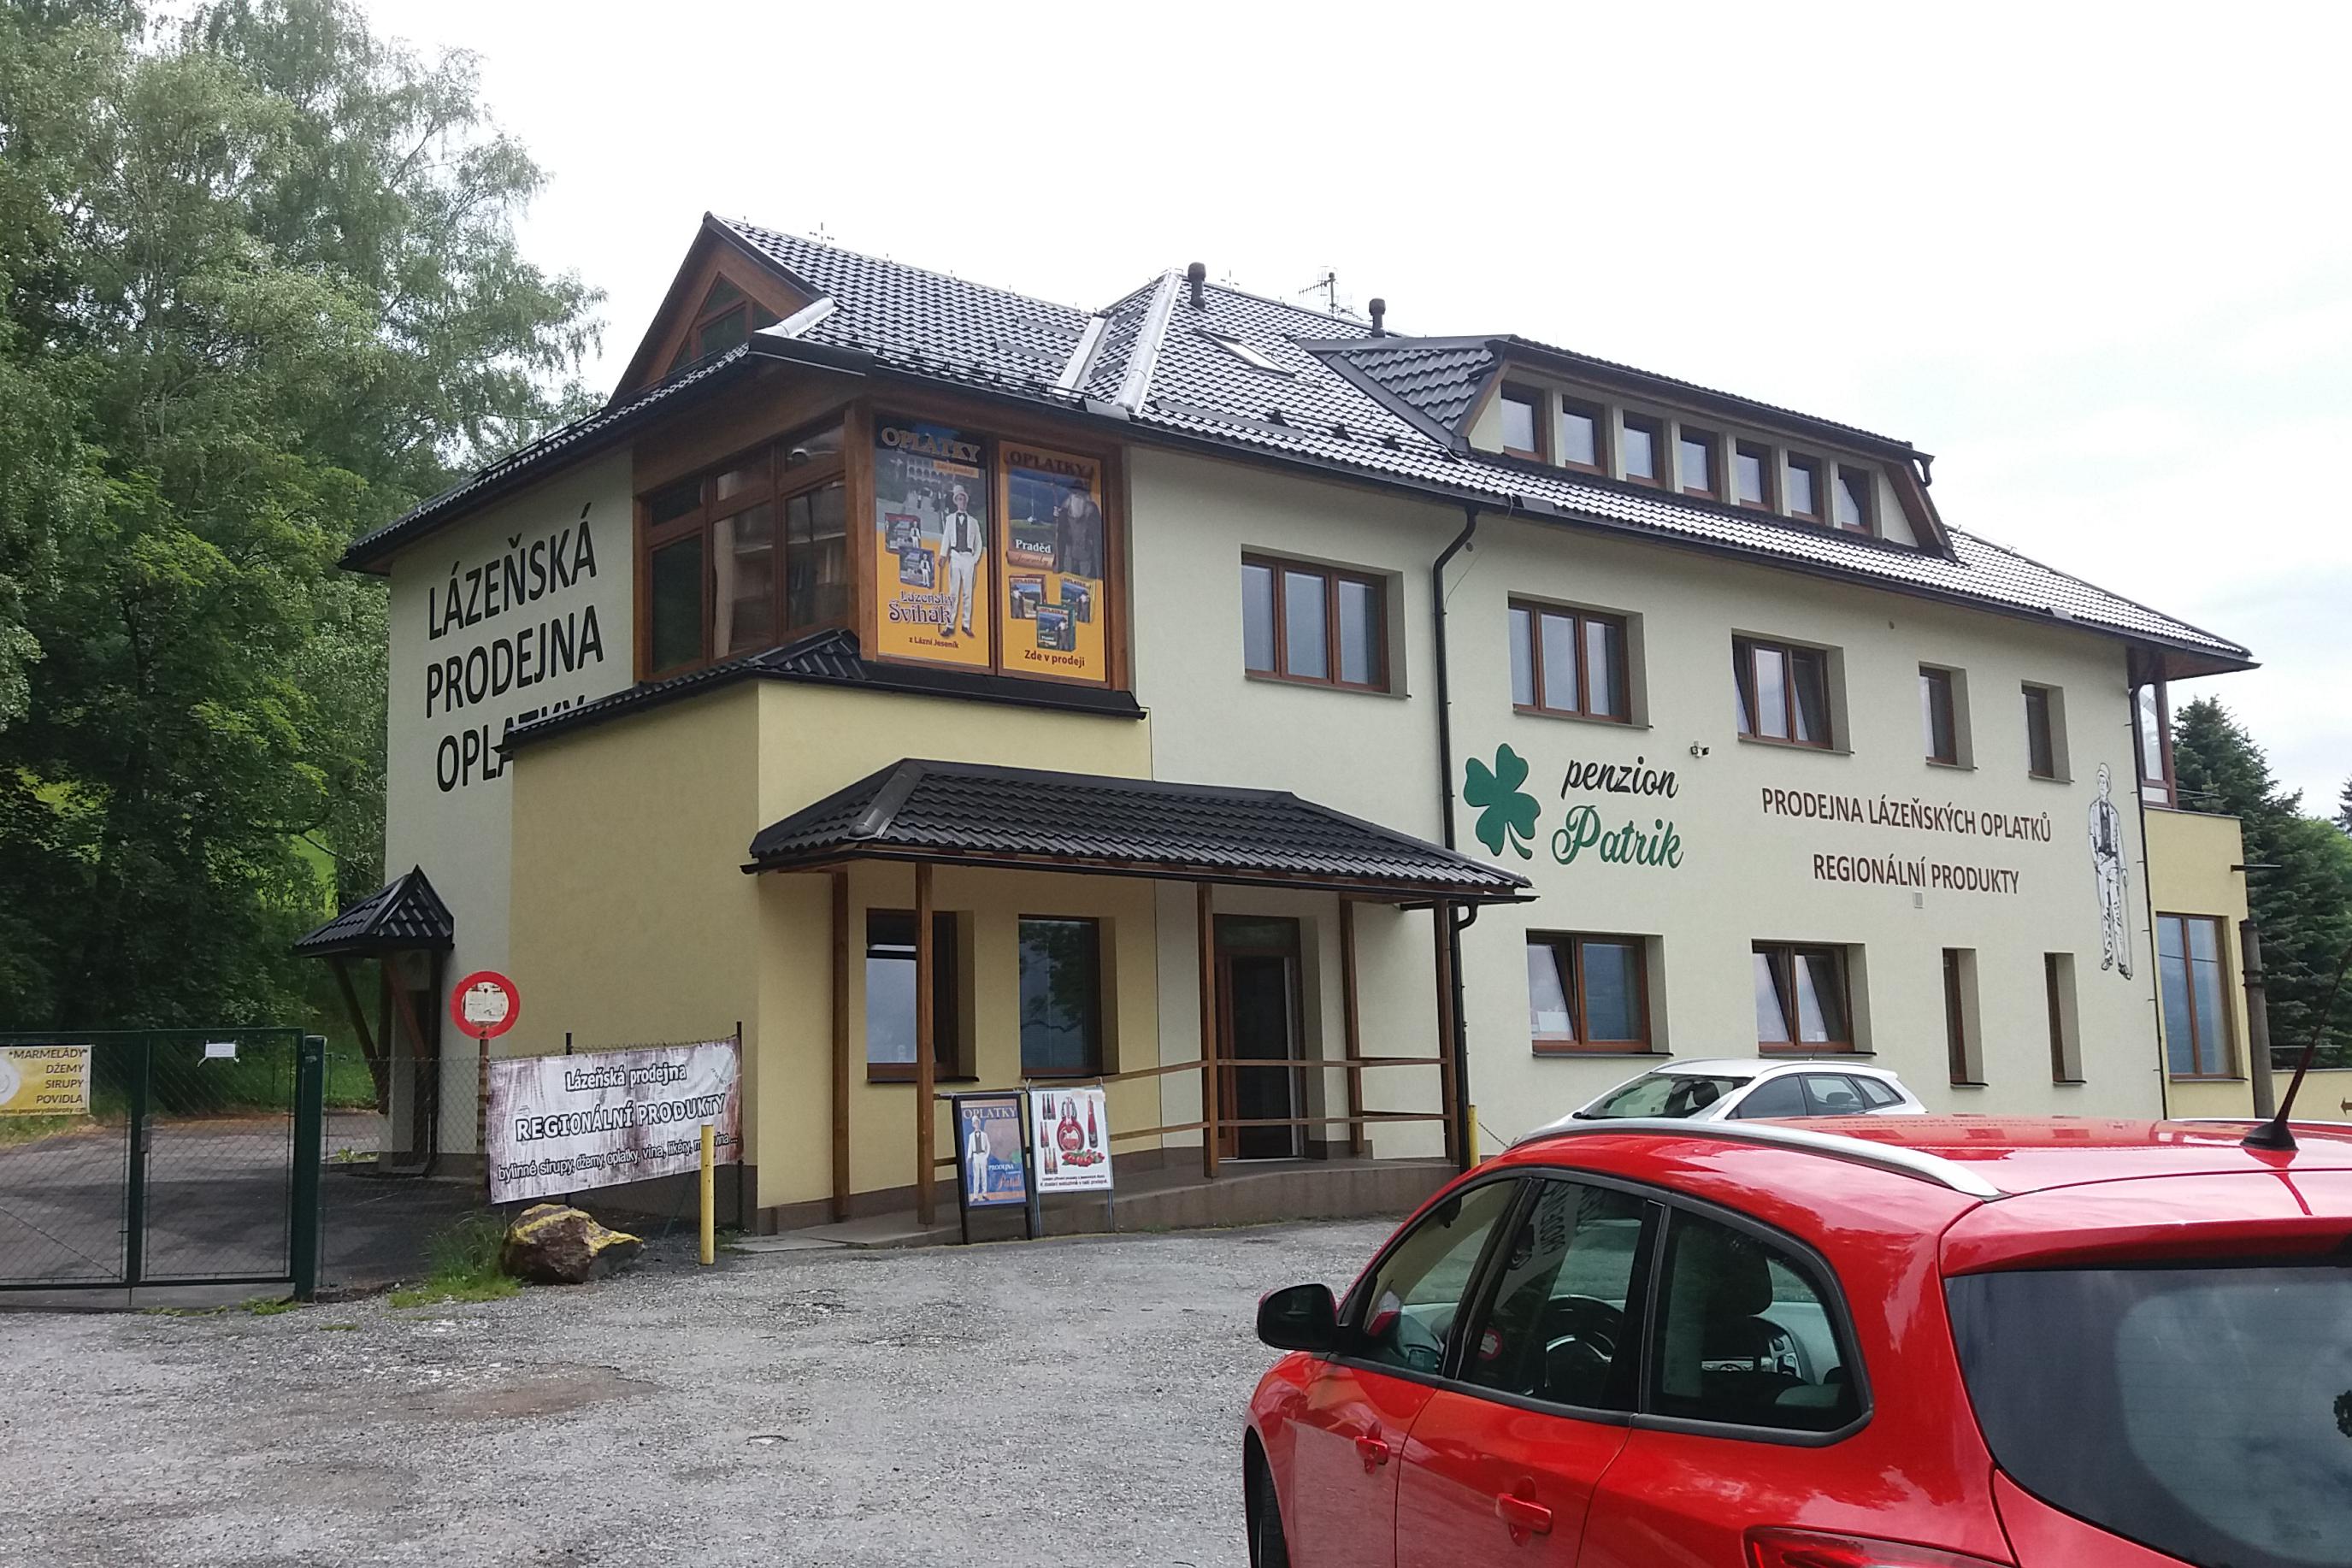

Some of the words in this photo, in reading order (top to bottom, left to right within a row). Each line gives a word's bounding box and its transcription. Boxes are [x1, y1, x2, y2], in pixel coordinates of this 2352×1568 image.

[881, 427, 981, 463] OPLATKY
[1009, 451, 1086, 476] OPLATKY
[429, 502, 598, 640] LÁZEŇSKÁ
[888, 600, 952, 624] Švihák
[426, 604, 604, 718] PRODEJNA
[1024, 650, 1042, 661] Zde
[1052, 653, 1085, 668] prodeji
[1560, 755, 1678, 799] penzion
[1761, 787, 1864, 823] PRODEJNA
[1868, 793, 1976, 835] LÁZEŇSKÝCH
[1980, 811, 2051, 842] OPLATKŮ
[1551, 805, 1684, 869] Patrik
[1813, 852, 1926, 887] REGIONÁLNÍ
[1931, 863, 2020, 894] PRODUKTY
[44, 1079, 84, 1088] SIRUPY
[565, 1064, 626, 1092] Lázeňská
[629, 1062, 687, 1089] prodejna
[36, 1094, 83, 1104] POVIDLA
[516, 1099, 634, 1141] REGIONÁLNÍ
[637, 1093, 726, 1126] PRODUKTY
[963, 1107, 1016, 1119] OPLATKY
[498, 1160, 537, 1184] bylinné
[539, 1158, 575, 1176] sirupy,
[576, 1153, 605, 1170] džemy,
[606, 1147, 641, 1167] oplatky,
[667, 1138, 693, 1157] likéry,
